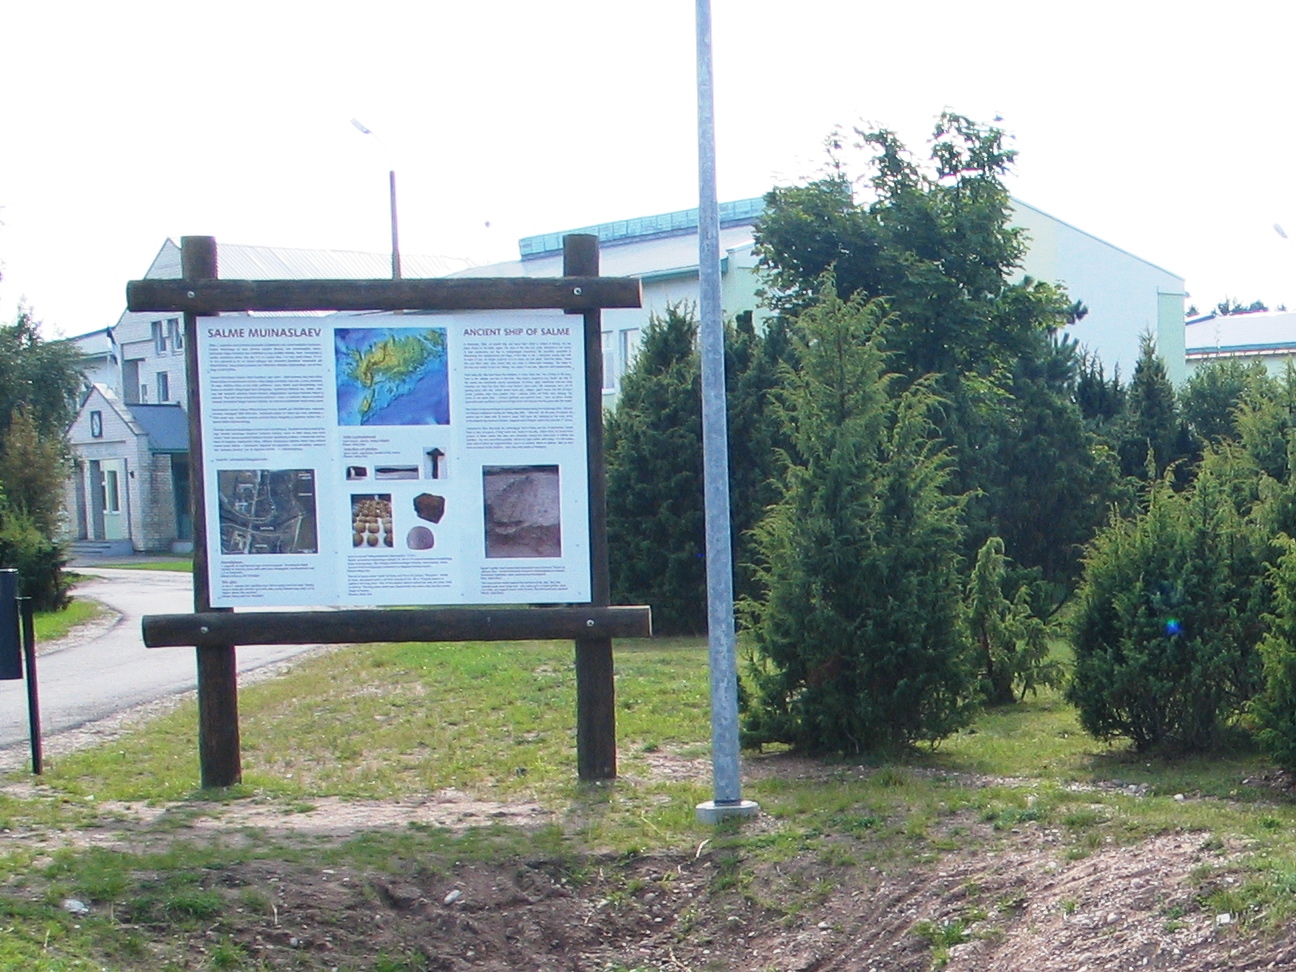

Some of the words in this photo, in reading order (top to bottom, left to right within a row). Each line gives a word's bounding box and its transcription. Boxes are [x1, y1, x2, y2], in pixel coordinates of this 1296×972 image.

[208, 328, 244, 338] SALME
[248, 328, 322, 338] MUINASLAEV
[463, 328, 501, 337] ANCIENT
[504, 328, 524, 336] SHIP
[526, 327, 538, 336] OF
[541, 327, 570, 336] SALME
